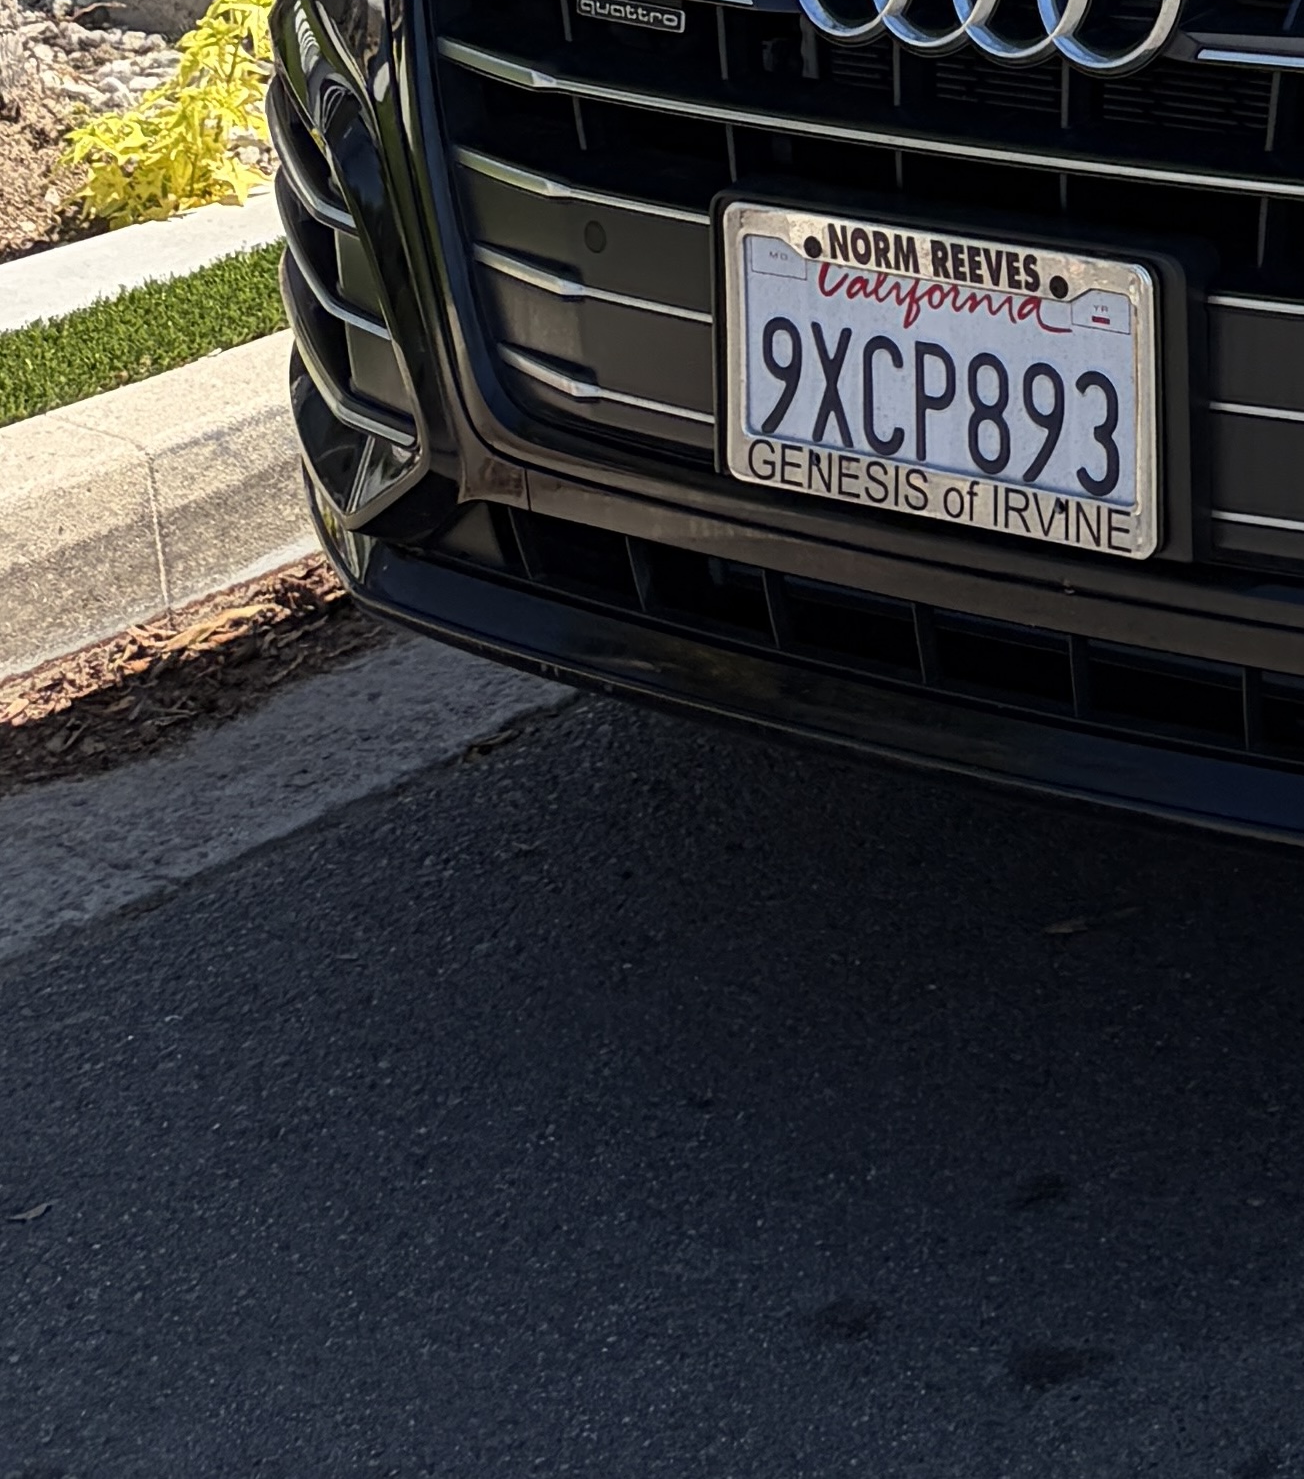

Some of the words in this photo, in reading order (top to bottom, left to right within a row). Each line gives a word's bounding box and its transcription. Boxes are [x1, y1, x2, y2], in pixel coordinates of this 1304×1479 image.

[817, 262, 1073, 332] California
[827, 222, 920, 274] NORM
[930, 238, 1041, 292] REEVES
[761, 316, 1121, 496] 9XCP893
[747, 438, 929, 512] GENESIS
[943, 480, 980, 521] of
[993, 484, 1132, 554] IRVINE
